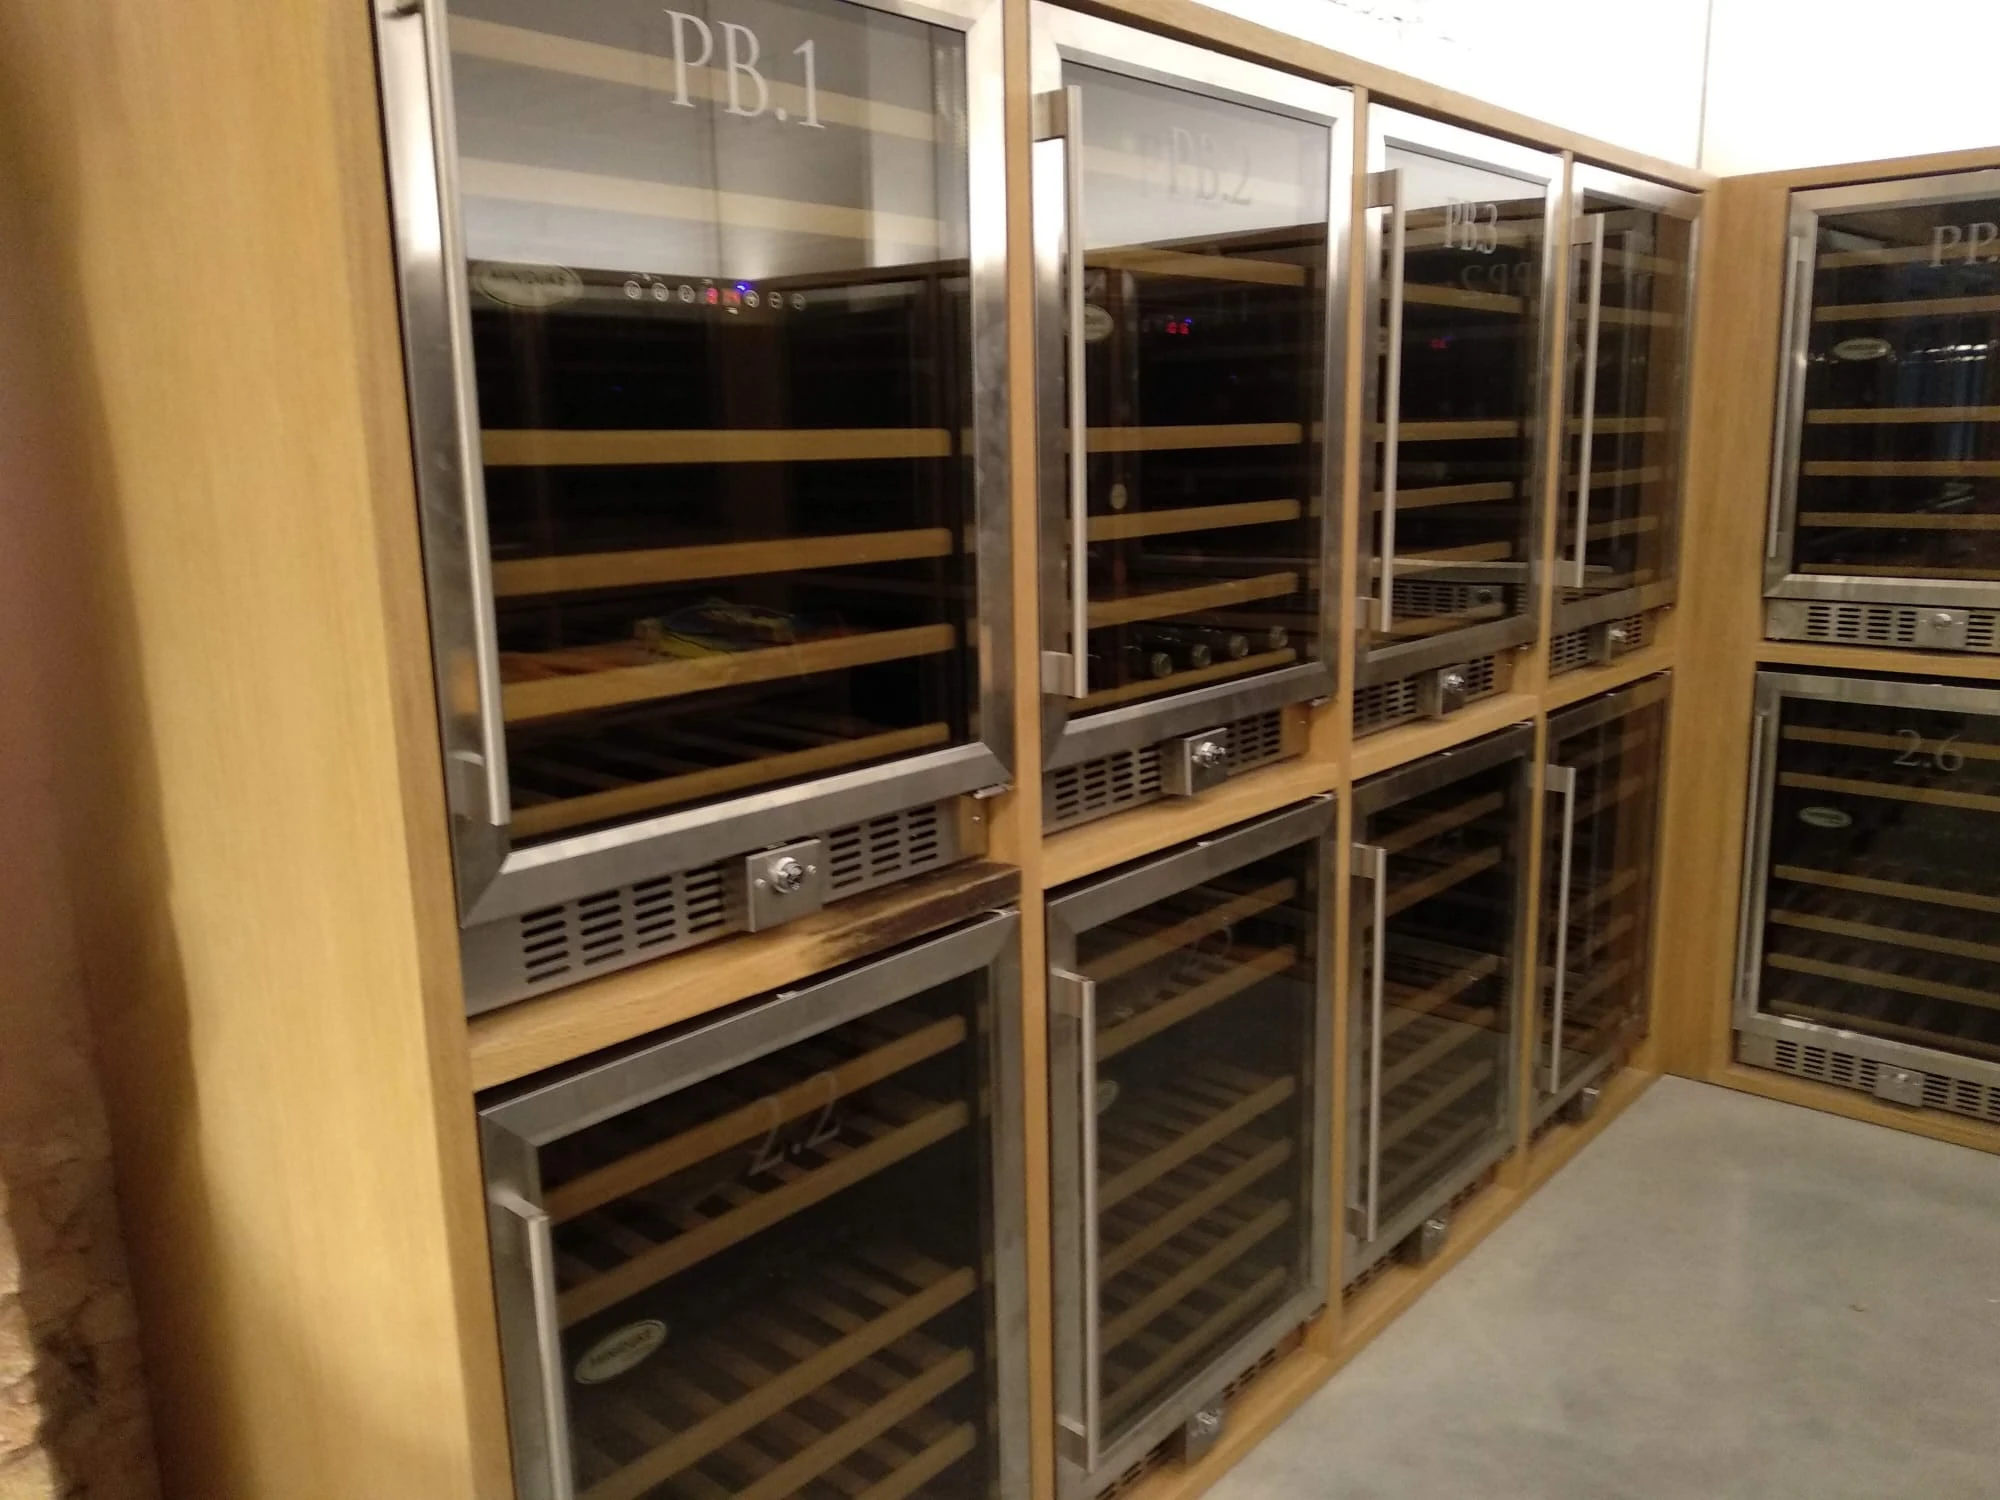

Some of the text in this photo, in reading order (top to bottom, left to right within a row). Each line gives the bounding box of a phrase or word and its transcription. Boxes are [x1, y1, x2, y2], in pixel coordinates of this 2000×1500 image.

[663, 9, 827, 129] PB.1
[1167, 125, 1253, 206] PB.2
[1443, 196, 1498, 255] PB.3
[1892, 729, 1964, 772] 2.6
[747, 1071, 842, 1177] 2.2
